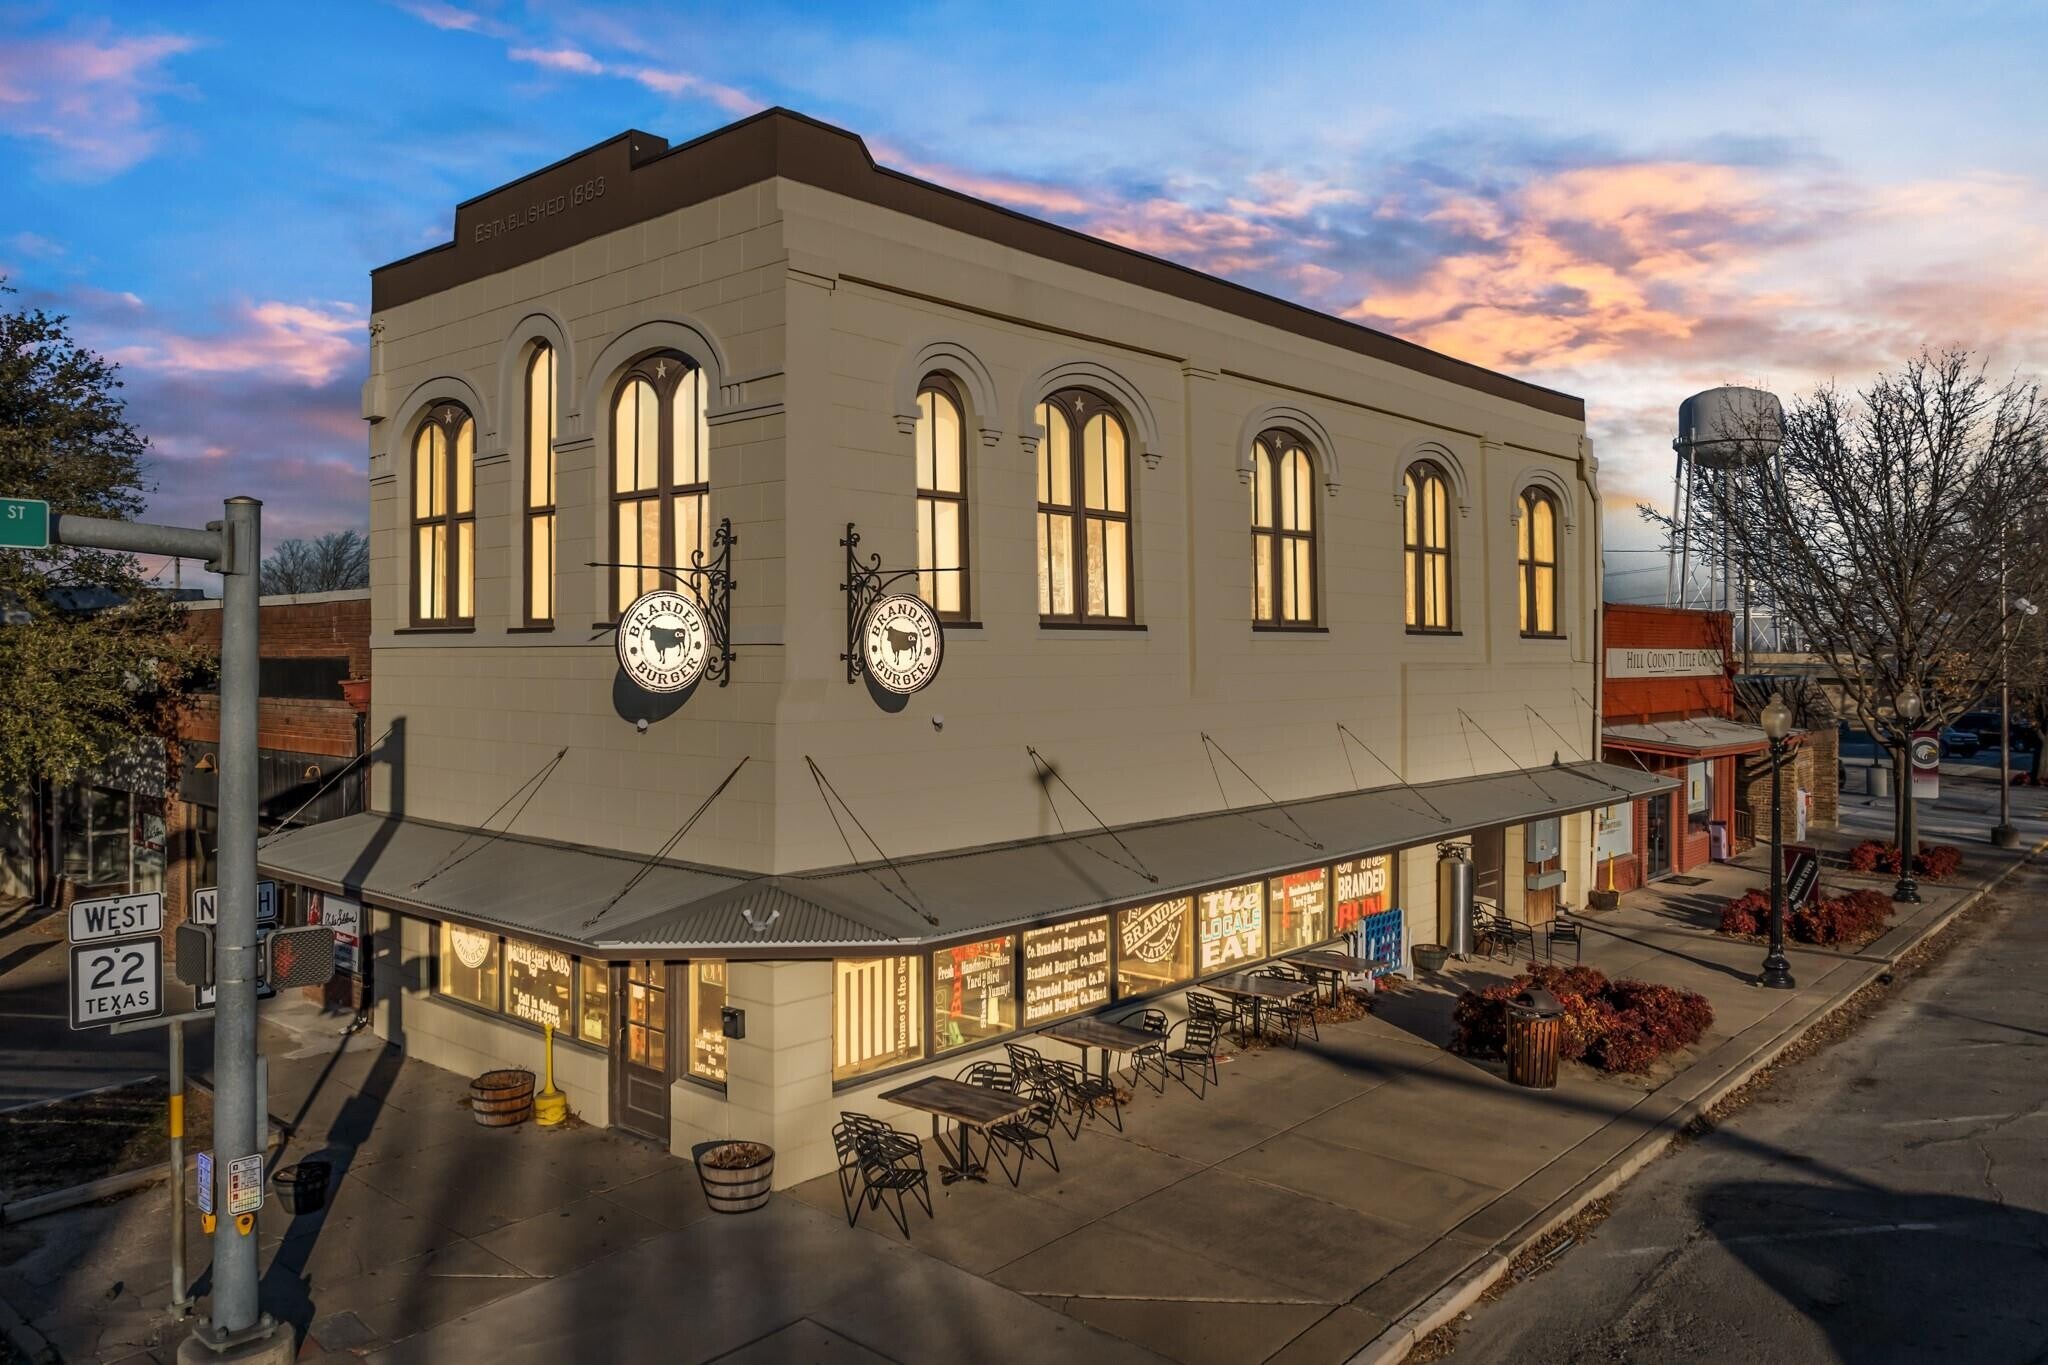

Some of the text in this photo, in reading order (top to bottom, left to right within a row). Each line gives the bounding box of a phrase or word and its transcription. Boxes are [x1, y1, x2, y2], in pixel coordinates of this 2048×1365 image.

[8, 505, 26, 519] ST
[629, 600, 700, 638] BRANDED
[872, 603, 931, 637] BRANDED
[635, 657, 698, 685] BURGER
[875, 660, 928, 685] BURGER
[1337, 868, 1386, 901] BRANDED
[1203, 892, 1258, 918] The
[84, 904, 149, 933] WEST
[1202, 908, 1261, 943] LOCALS
[1063, 935, 1087, 952] Burgers
[1202, 931, 1261, 969] EAT
[90, 951, 145, 990] 22
[937, 964, 954, 980] Fresh
[961, 956, 990, 975] Handmade
[966, 969, 1000, 990] Yard Bird
[1027, 961, 1053, 980] Branded
[1054, 959, 1078, 975] Burgers
[897, 975, 907, 997] the
[988, 981, 1010, 997] Yummy!
[1063, 977, 1087, 993] Burgers
[86, 990, 149, 1016] TEXAS
[531, 995, 538, 1008] in
[897, 999, 906, 1013] of
[1027, 1000, 1053, 1020] Branded
[1054, 996, 1078, 1013] Burgers
[897, 1014, 907, 1050] Home
